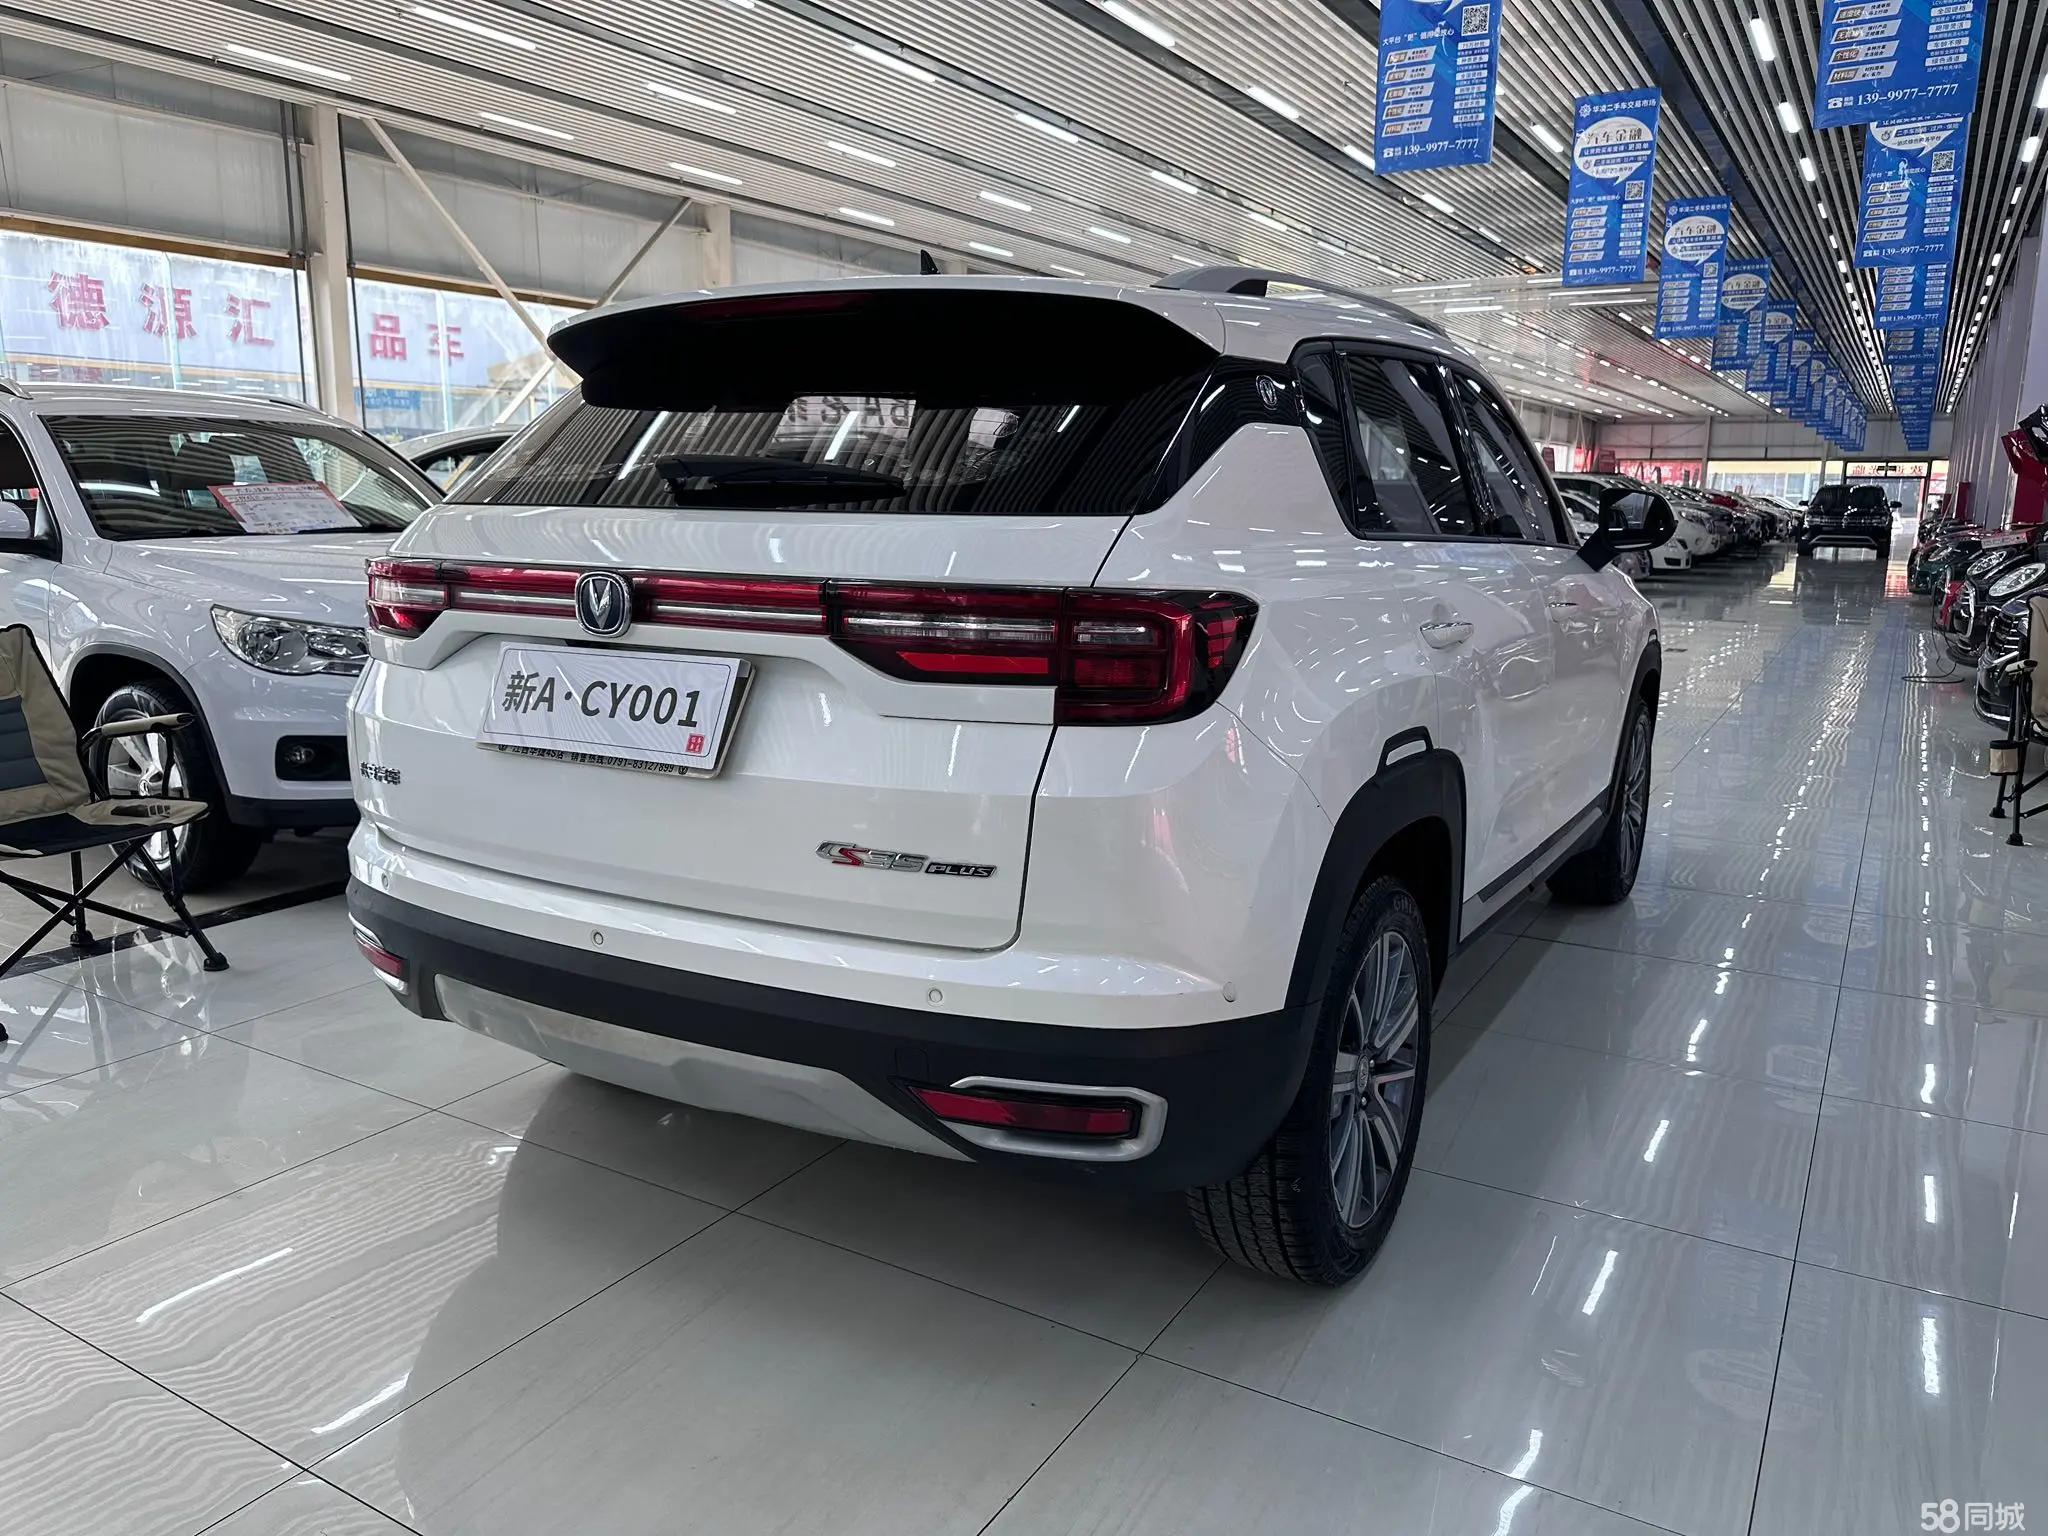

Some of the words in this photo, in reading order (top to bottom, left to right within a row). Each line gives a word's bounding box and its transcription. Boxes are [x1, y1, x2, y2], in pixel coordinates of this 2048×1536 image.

[1857, 83, 1959, 106] 139-9977-7777
[1404, 138, 1479, 156] 139-9977-7777
[1882, 243, 1944, 256] 139-9977-7777
[47, 271, 276, 348] 德源汇
[815, 840, 929, 872] CS35
[926, 863, 995, 878] PLUS
